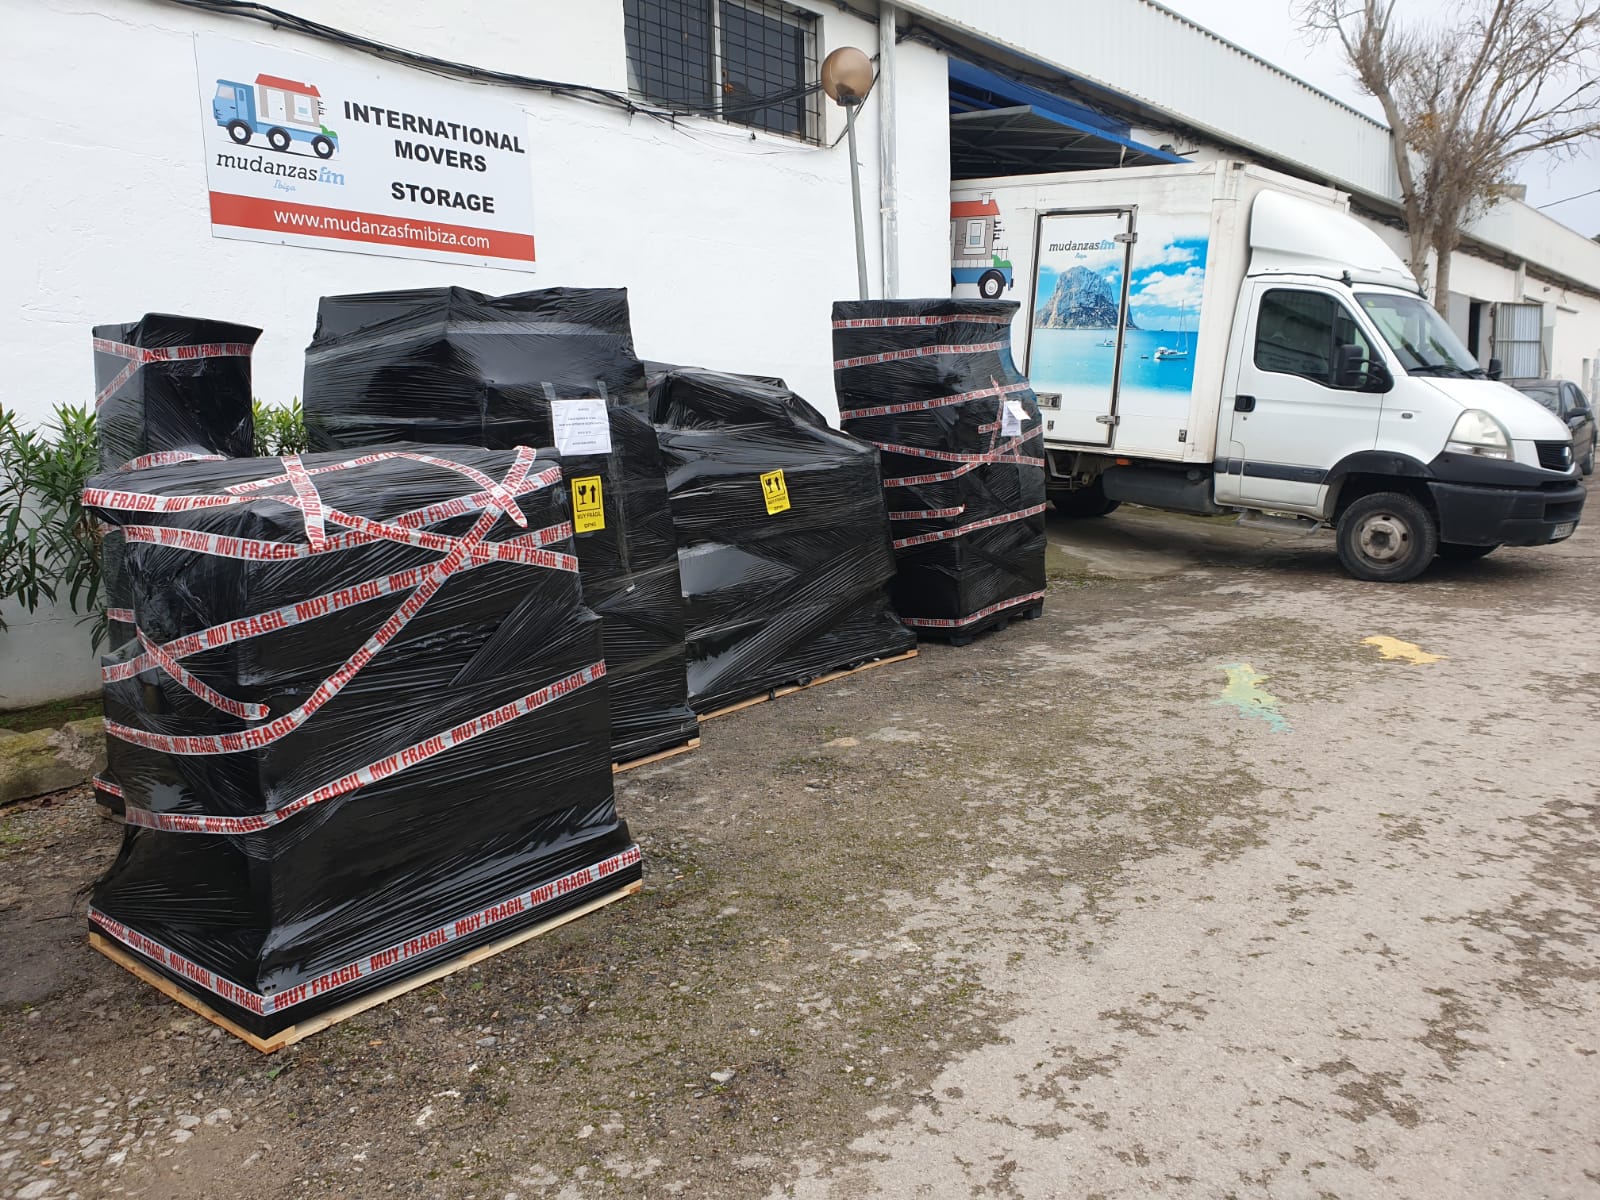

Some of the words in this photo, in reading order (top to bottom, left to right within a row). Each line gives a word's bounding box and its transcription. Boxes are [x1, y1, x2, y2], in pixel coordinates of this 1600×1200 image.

[344, 100, 525, 154] INTERNATIONAL
[394, 139, 487, 172] MOVERS
[391, 182, 495, 214] STORAGE
[273, 209, 490, 249] www.mudanzasfmibiza.com
[177, 345, 199, 359] MUY
[201, 343, 223, 357] FRAGIL
[136, 456, 152, 470] MUY
[456, 463, 499, 495] FRAGIL
[499, 494, 525, 521] MUY
[83, 488, 109, 505] MUY
[110, 491, 157, 511] FRAGIL
[163, 496, 189, 511] MUY
[329, 509, 364, 529] MUY
[366, 521, 411, 543] FRAGIL
[418, 532, 447, 549] MUY
[497, 543, 522, 560] MUY
[524, 548, 557, 568] FRAGIL
[127, 526, 157, 542] FRAGIL
[159, 529, 178, 544] MUY
[180, 531, 210, 552] FRAGIL
[215, 537, 239, 555] MUY
[241, 540, 299, 560] FRAGIL
[397, 514, 424, 529] MUY
[427, 500, 470, 522] FRAGIL
[175, 633, 203, 656] FRAGIL
[206, 624, 228, 647] MUY
[231, 610, 289, 640] FRAGIL
[295, 596, 329, 621] MUY
[332, 580, 382, 609] FRAGIL
[388, 568, 418, 591] MUY
[540, 526, 561, 545] MUY
[171, 737, 188, 753] MUY
[189, 736, 220, 753] FRAGIL
[220, 732, 244, 751] MUY
[244, 715, 299, 747] FRAGIL
[302, 684, 332, 716] MUY
[327, 647, 375, 690] FRAGIL
[374, 614, 403, 646] MUY
[400, 576, 441, 620] FRAGIL
[438, 546, 465, 577] MUY
[462, 511, 497, 550] FRAGIL
[187, 674, 207, 702] MUY
[208, 691, 250, 718] FRAGIL
[159, 814, 171, 830] MUY
[174, 815, 203, 832] FRAGIL
[205, 817, 224, 833] MUY
[225, 815, 269, 833] FRAGIL
[275, 797, 310, 820] MUY
[313, 773, 365, 803] FRAGIL
[368, 754, 399, 780] MUY
[401, 735, 446, 766] FRAGIL
[451, 721, 477, 744] MUY
[480, 703, 521, 731] FRAGIL
[525, 688, 549, 710] MUY
[551, 671, 587, 698] FRAGIL
[591, 661, 606, 680] MU
[127, 929, 143, 949] MUY
[143, 938, 167, 964] FRAGIL
[169, 952, 186, 975] MUY
[186, 961, 213, 989] FRAGIL
[216, 974, 235, 998] MUY
[235, 985, 264, 1015] FRAGIL
[273, 983, 308, 1010] MUY
[311, 962, 363, 995] FRAGIL
[370, 947, 400, 972] MUY
[403, 927, 449, 958] FRAGIL
[455, 913, 482, 937] MUY
[484, 897, 525, 923] FRAGIL
[530, 883, 555, 906] MUY
[557, 868, 593, 895] FRAGIL
[598, 856, 620, 877] MUY
[622, 847, 641, 867] FRA
